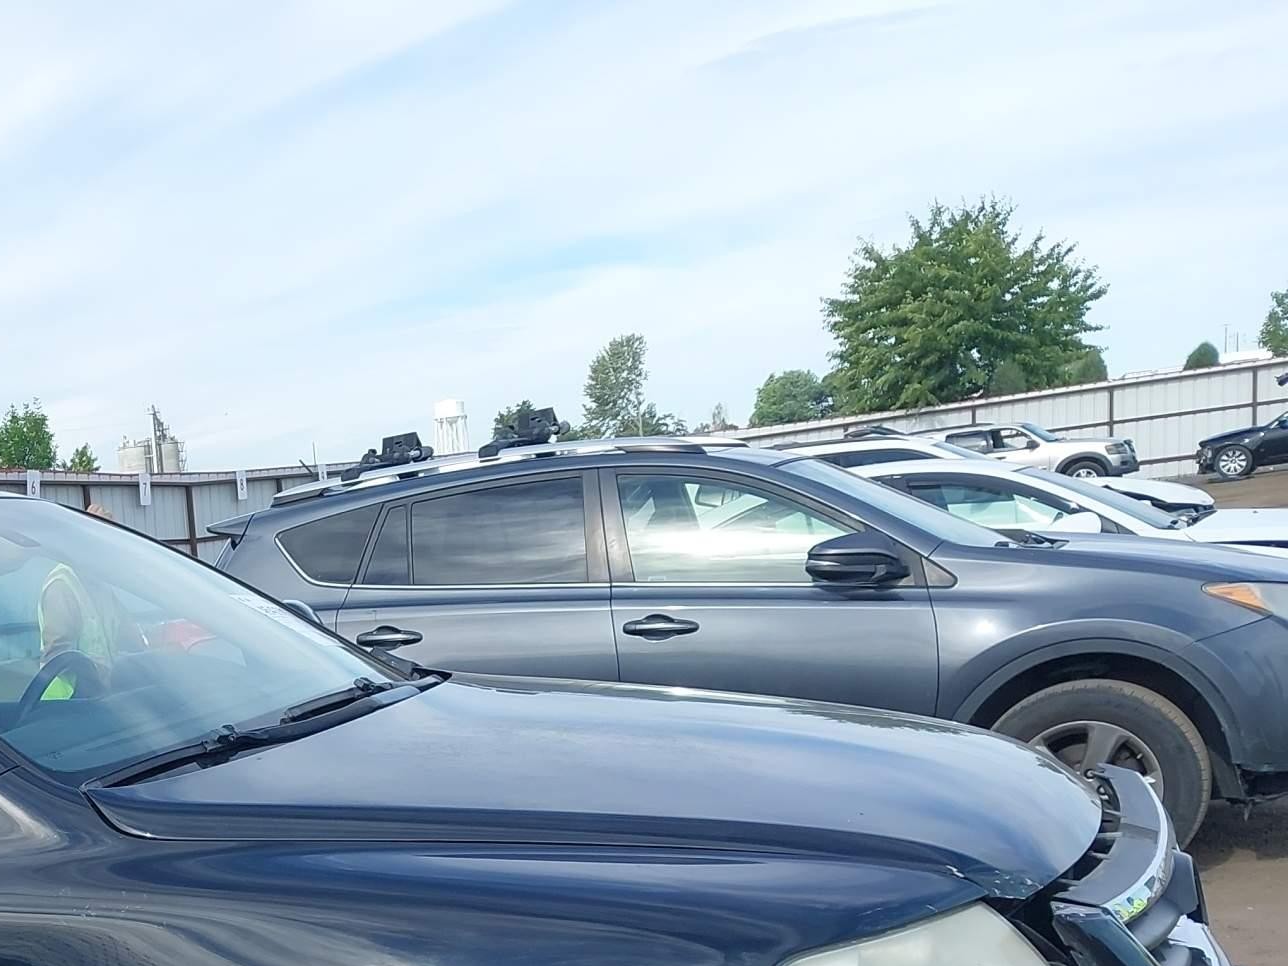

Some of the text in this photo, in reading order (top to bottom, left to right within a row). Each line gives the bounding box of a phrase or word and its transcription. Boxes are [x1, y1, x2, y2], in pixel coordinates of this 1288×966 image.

[31, 480, 37, 495] 6
[142, 482, 148, 496] 7
[239, 478, 245, 491] 8
